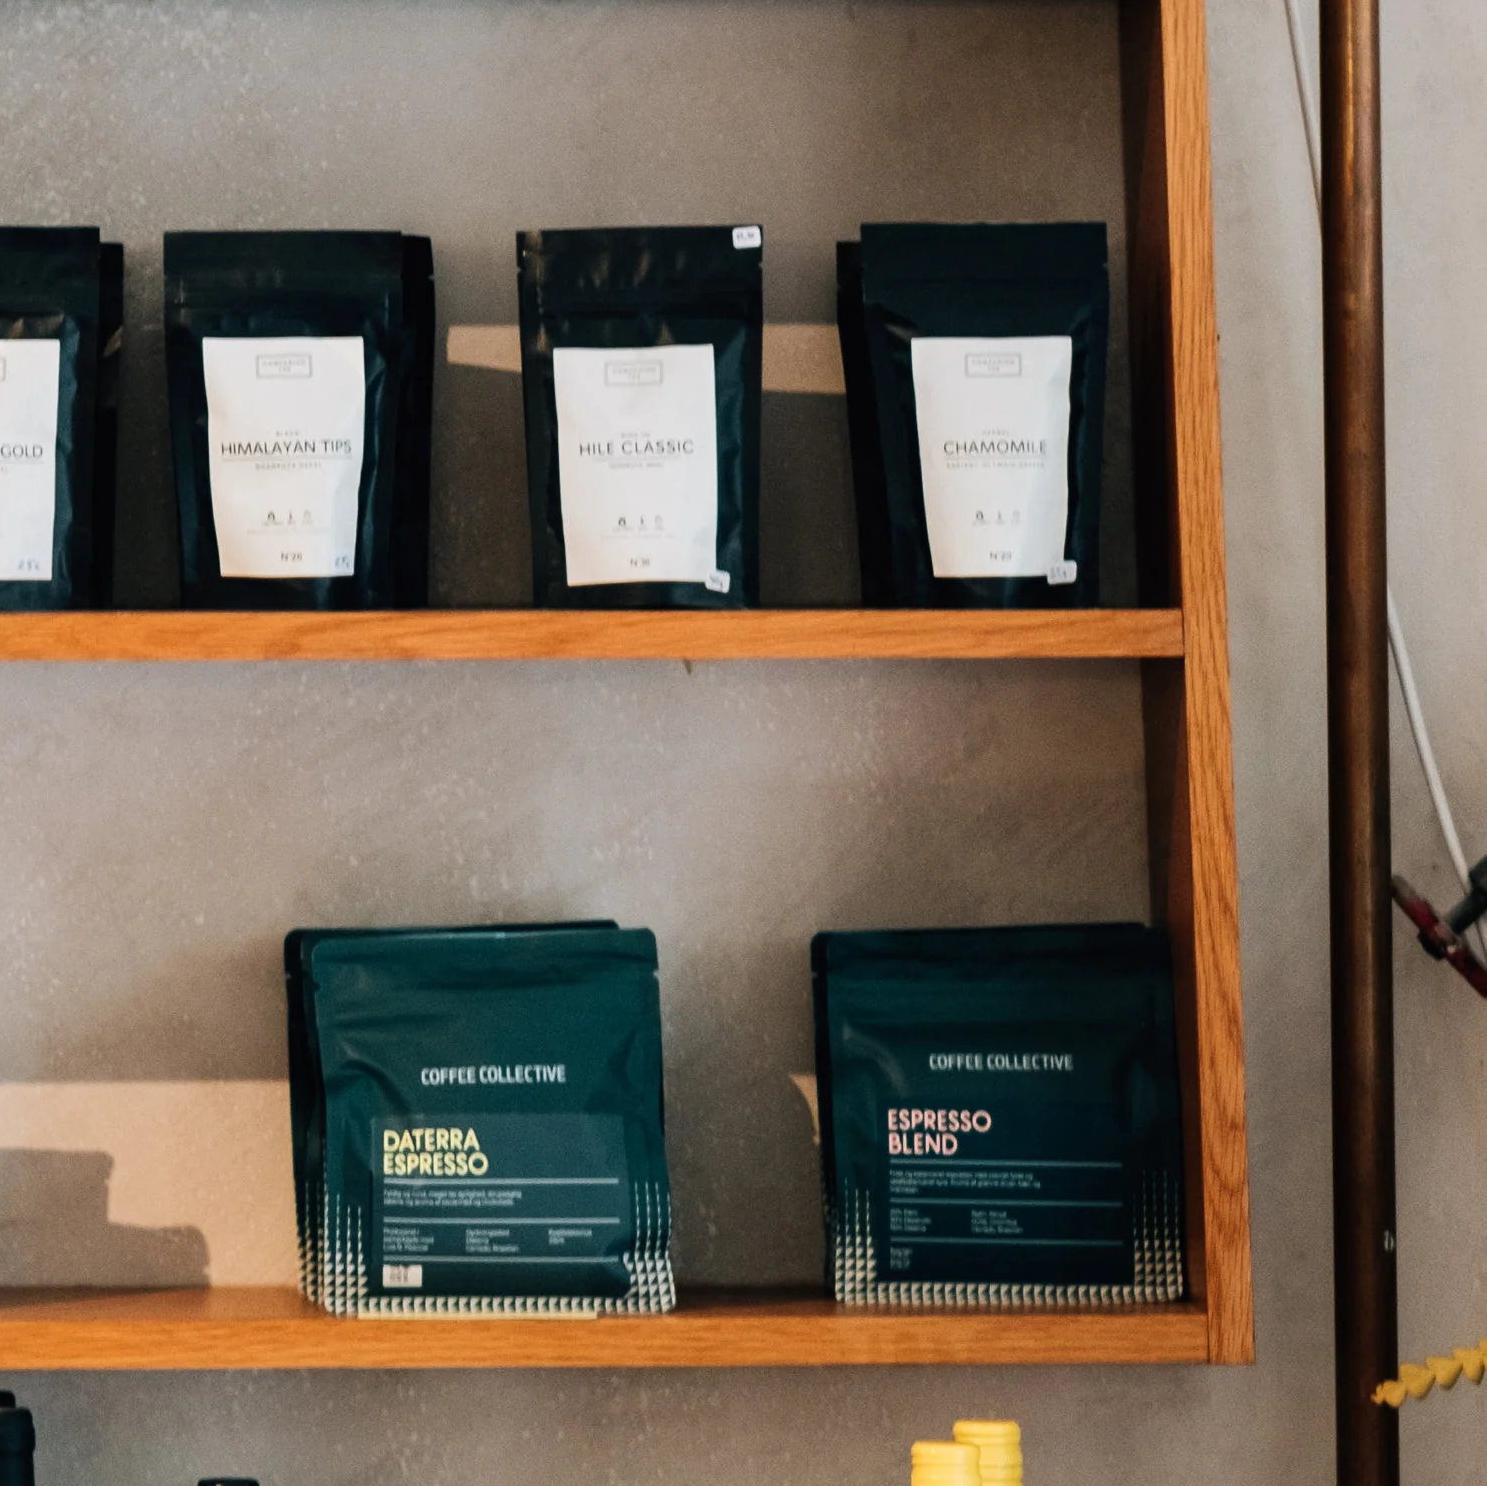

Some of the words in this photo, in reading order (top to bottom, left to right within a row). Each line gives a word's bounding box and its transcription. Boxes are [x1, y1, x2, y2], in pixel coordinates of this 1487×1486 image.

[0, 443, 43, 460] GOLD
[220, 439, 315, 456] HIMALAYAN
[320, 438, 352, 455] TIPS
[579, 441, 614, 457] HILE
[621, 439, 695, 456] CLASSIC
[943, 438, 1047, 457] CHAMOMILE
[929, 1053, 984, 1071] COFFEE
[986, 1053, 1074, 1071] COLLECTIVE
[420, 1066, 476, 1086] COFFEE
[479, 1063, 567, 1085] COLLECTIVE
[887, 1108, 992, 1133] ESPRESSO
[383, 1127, 481, 1152] DATERRA
[888, 1133, 959, 1156] BLEND
[383, 1152, 490, 1176] ESPRESSO
